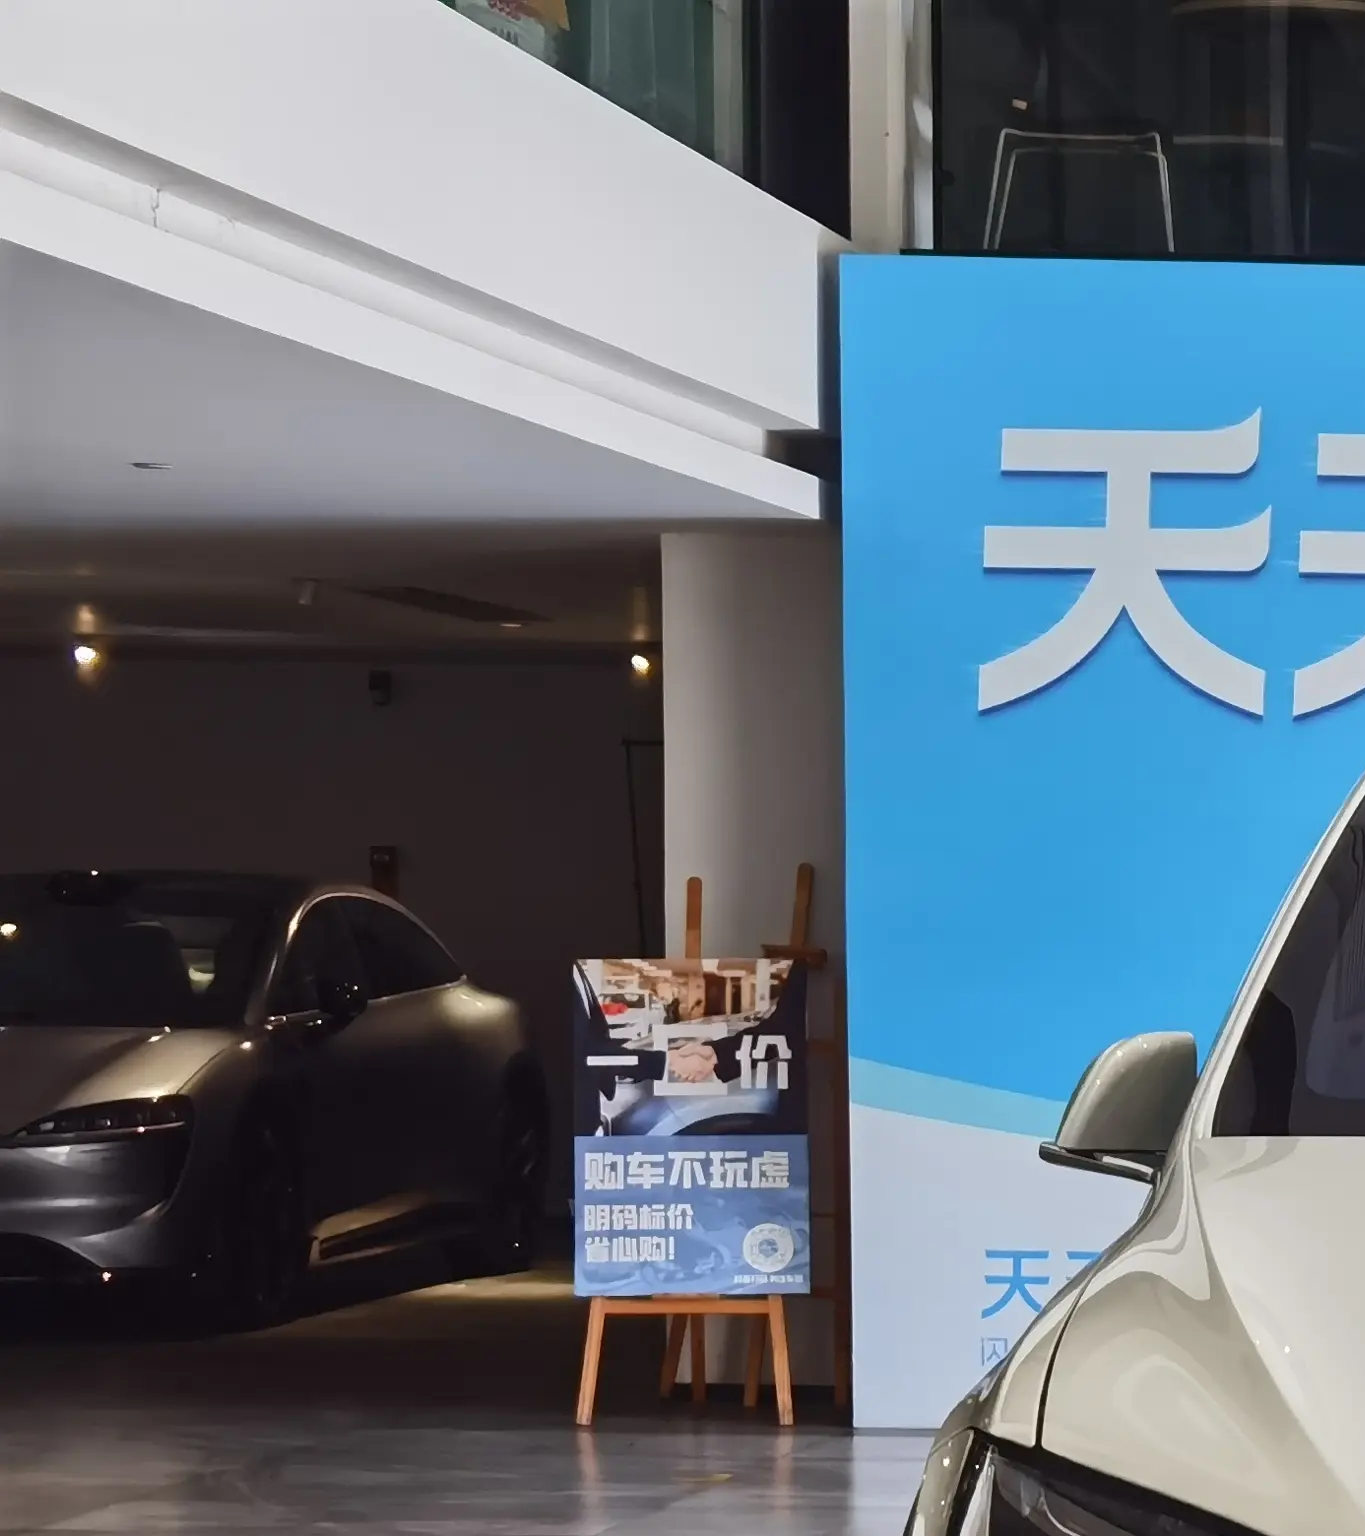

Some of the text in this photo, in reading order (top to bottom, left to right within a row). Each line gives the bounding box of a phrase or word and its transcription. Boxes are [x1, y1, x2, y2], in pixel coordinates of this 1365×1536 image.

[584, 1151, 790, 1190] 购车不玩虚
[584, 1203, 694, 1231] 明码标价
[980, 1248, 1101, 1319] 天
